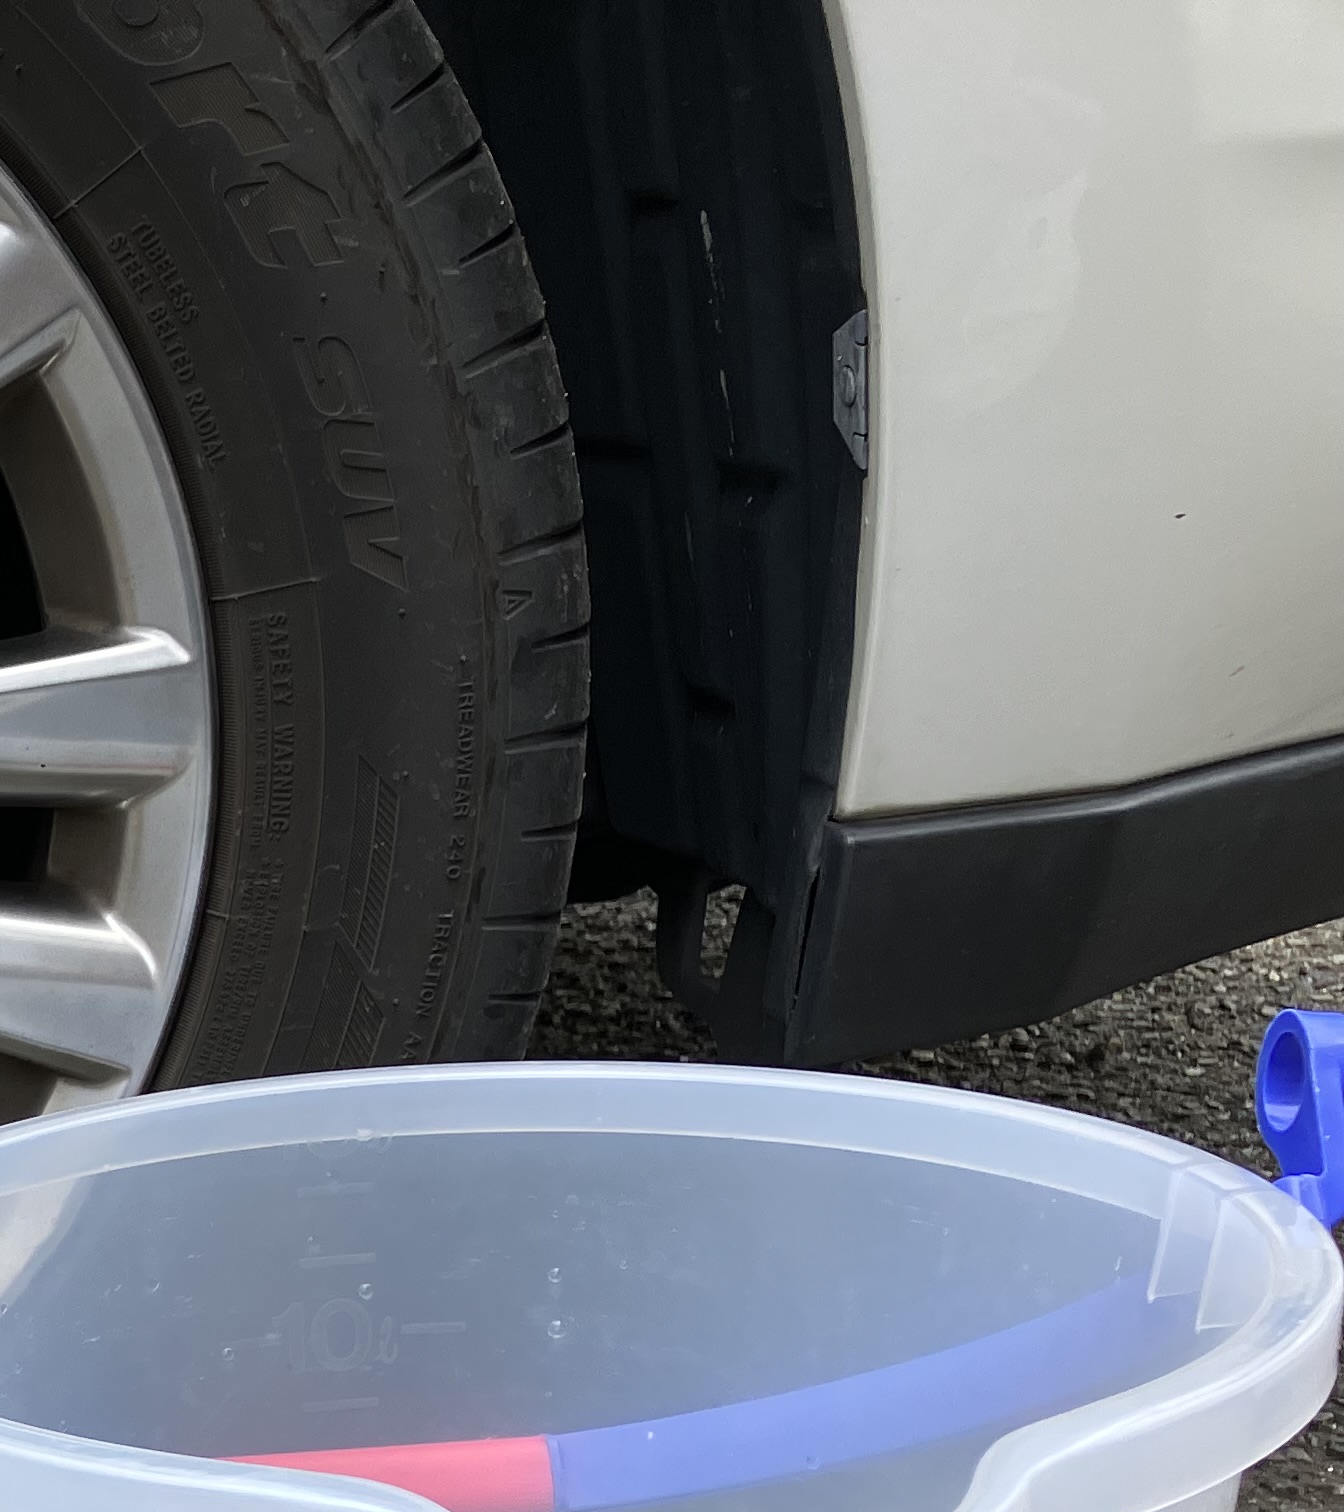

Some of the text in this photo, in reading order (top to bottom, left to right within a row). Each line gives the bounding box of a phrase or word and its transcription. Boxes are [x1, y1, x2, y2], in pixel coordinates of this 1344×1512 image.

[131, 221, 200, 324] TUBELESS
[108, 231, 228, 473] STEEL BELTED RADIAL
[291, 336, 411, 593] SUV
[267, 612, 295, 707] SAFETY
[444, 677, 476, 881] TREADWEAR 240
[416, 910, 455, 1018] TRACTION
